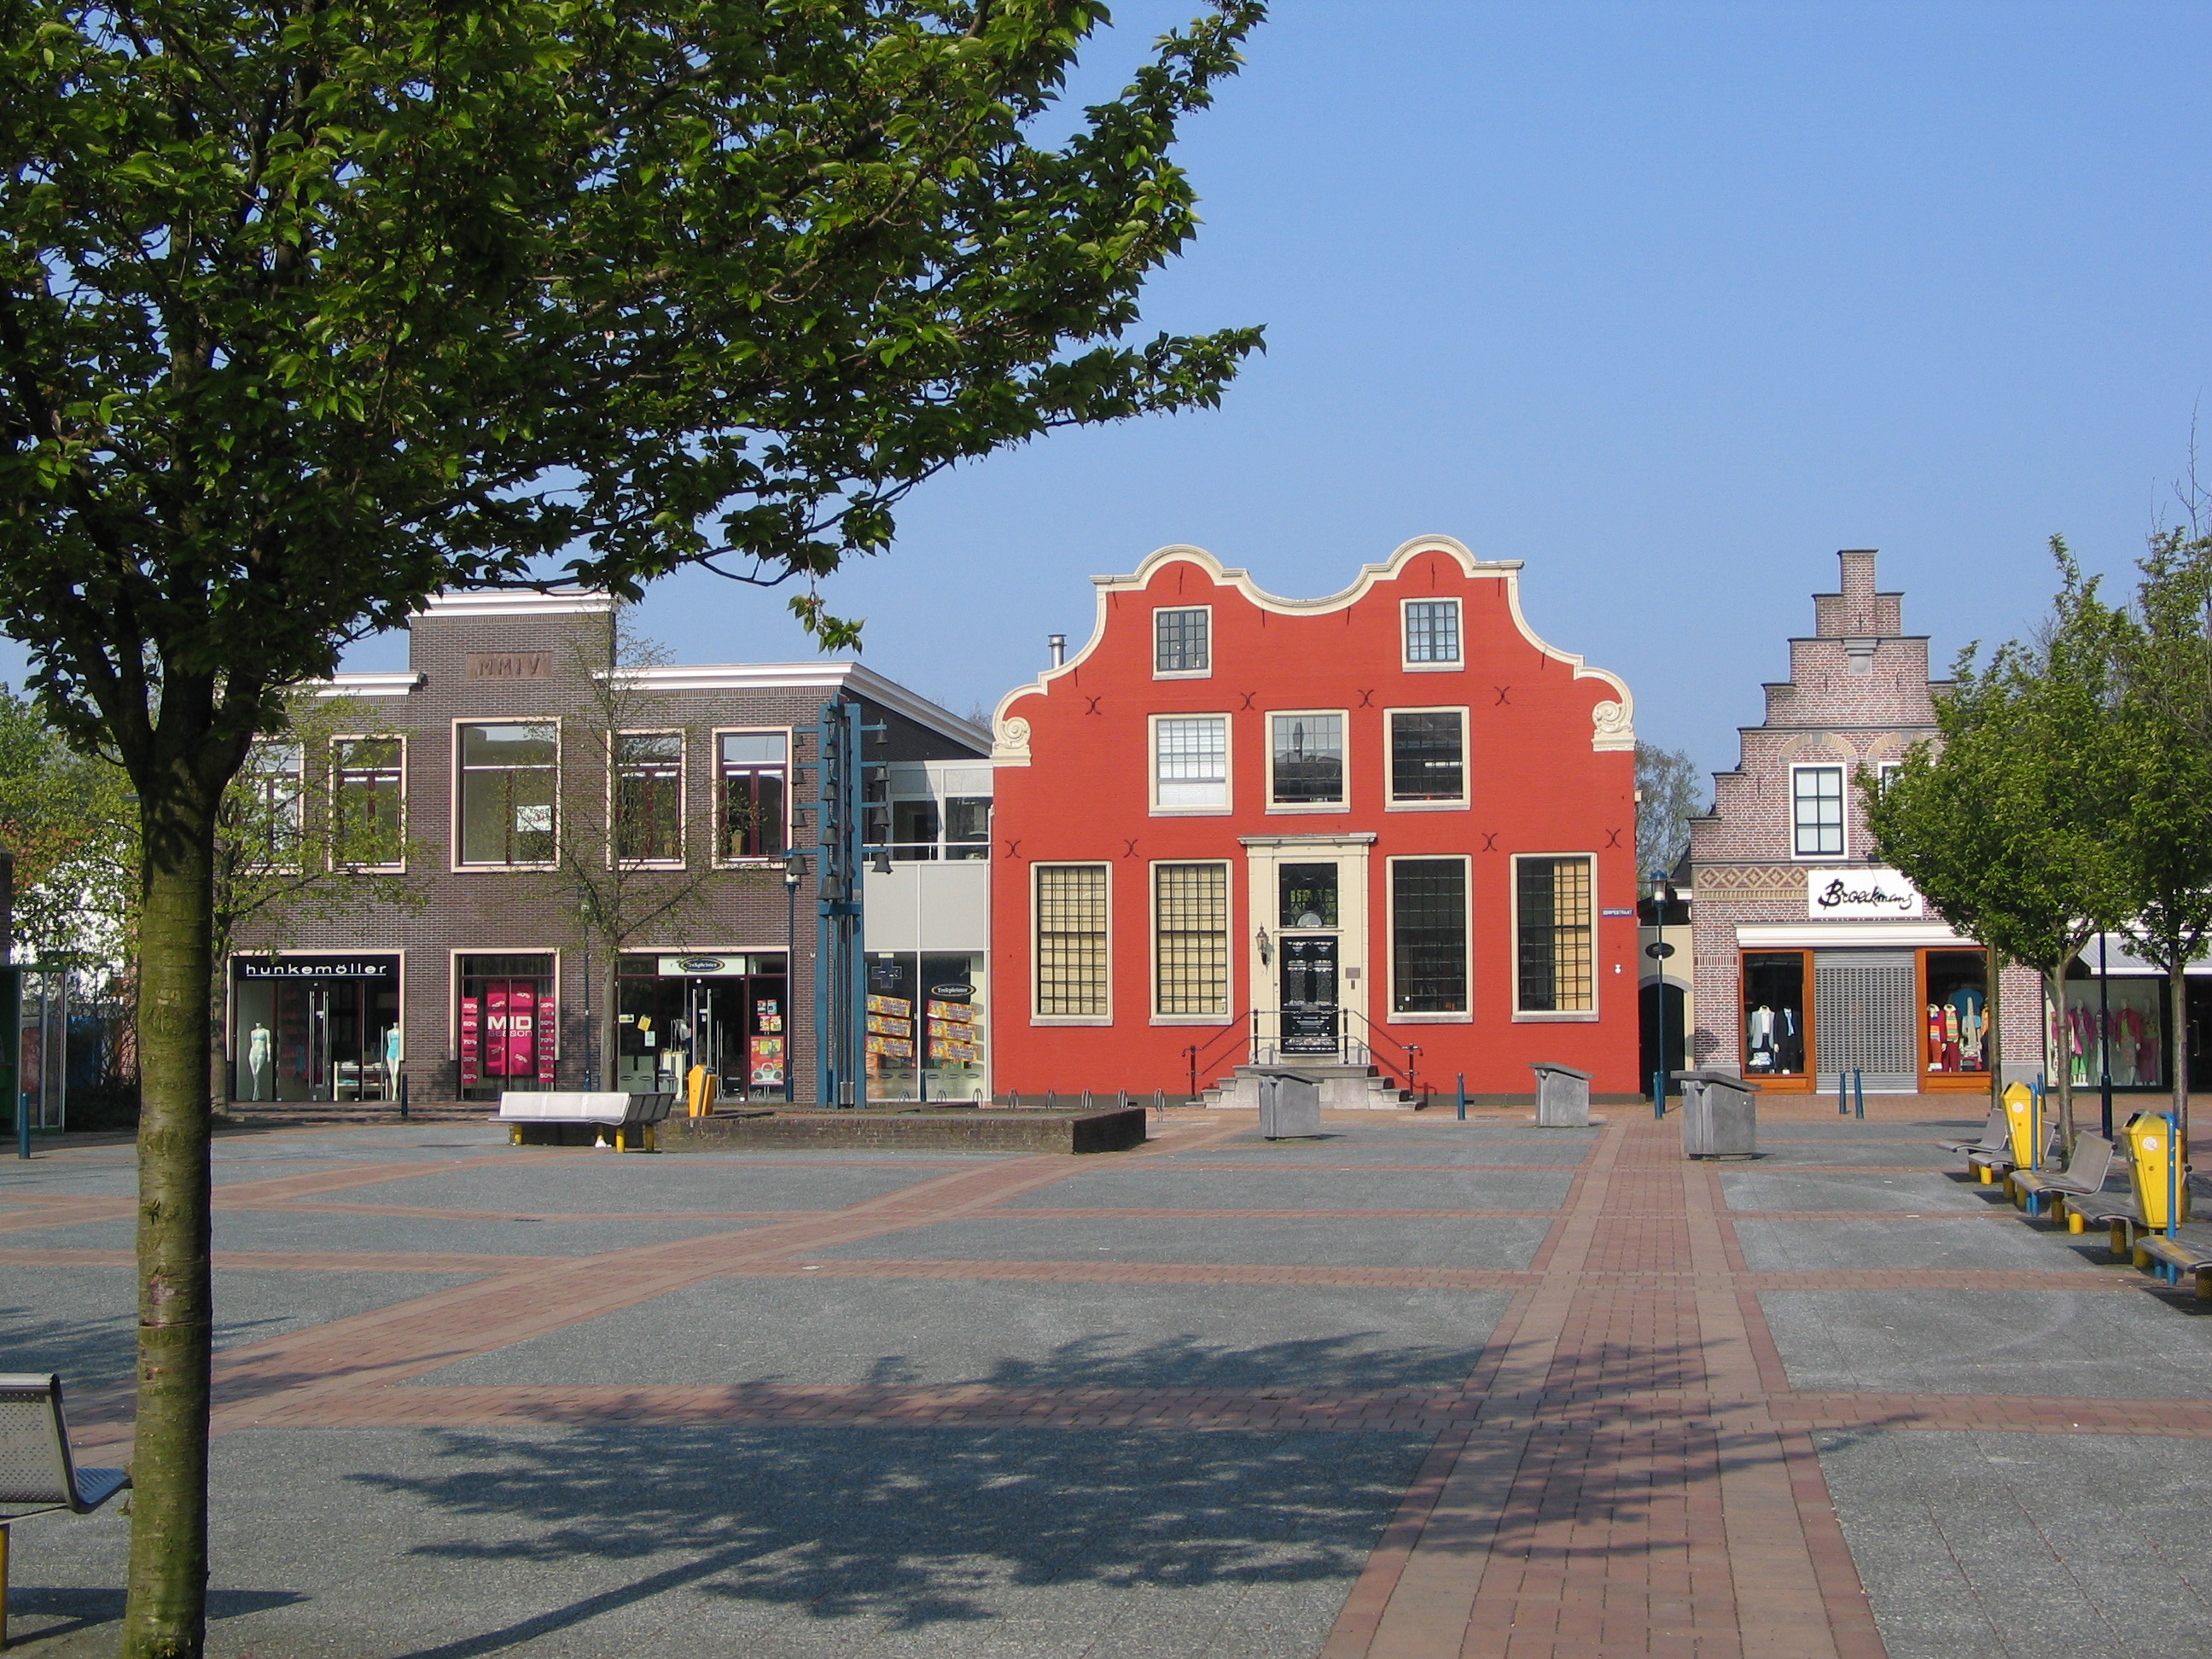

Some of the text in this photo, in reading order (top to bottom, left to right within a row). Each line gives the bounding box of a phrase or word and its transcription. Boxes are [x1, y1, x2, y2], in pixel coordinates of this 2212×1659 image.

[480, 656, 540, 676] MMIV
[1818, 878, 1913, 910] Broeckmans
[246, 963, 387, 975] hunkemöller
[487, 1016, 533, 1030] MID
